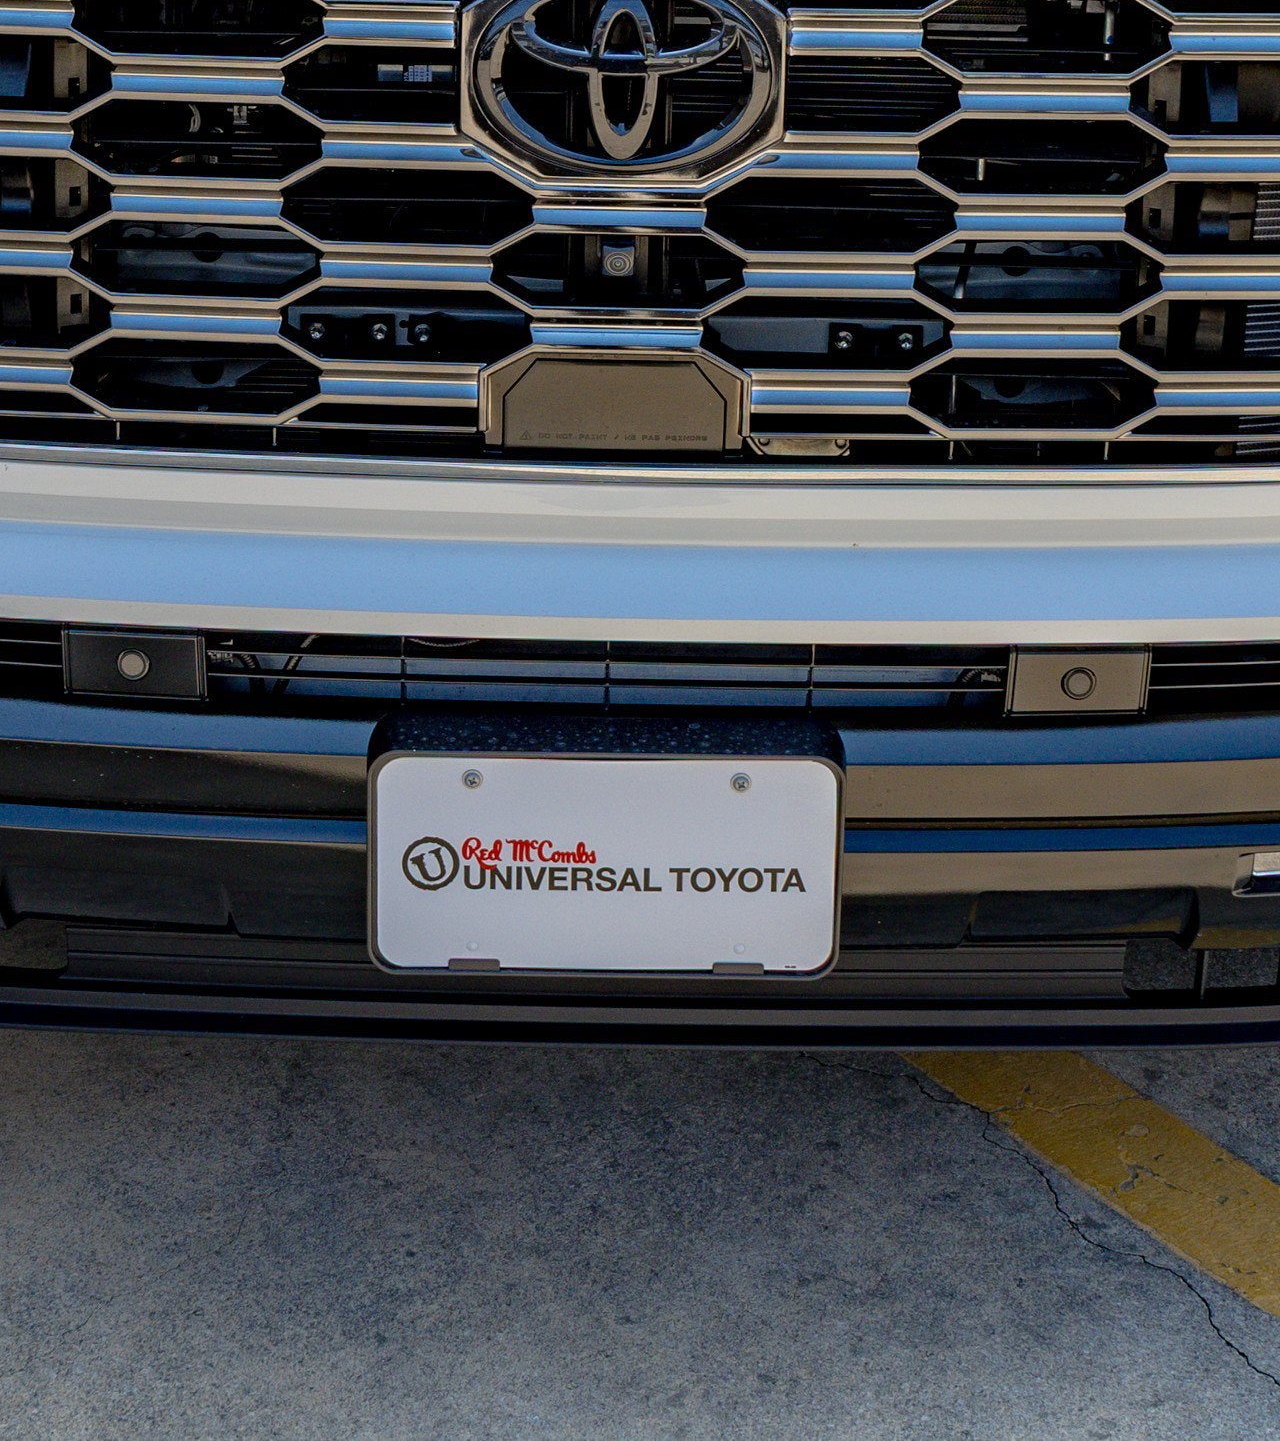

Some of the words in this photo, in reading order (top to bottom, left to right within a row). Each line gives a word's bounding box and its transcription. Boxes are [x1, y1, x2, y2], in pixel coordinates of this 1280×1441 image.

[461, 836, 502, 871] Red
[505, 838, 597, 865] McCombs
[463, 865, 662, 893] UNIVERSAL
[669, 867, 807, 894] TOYOTA
